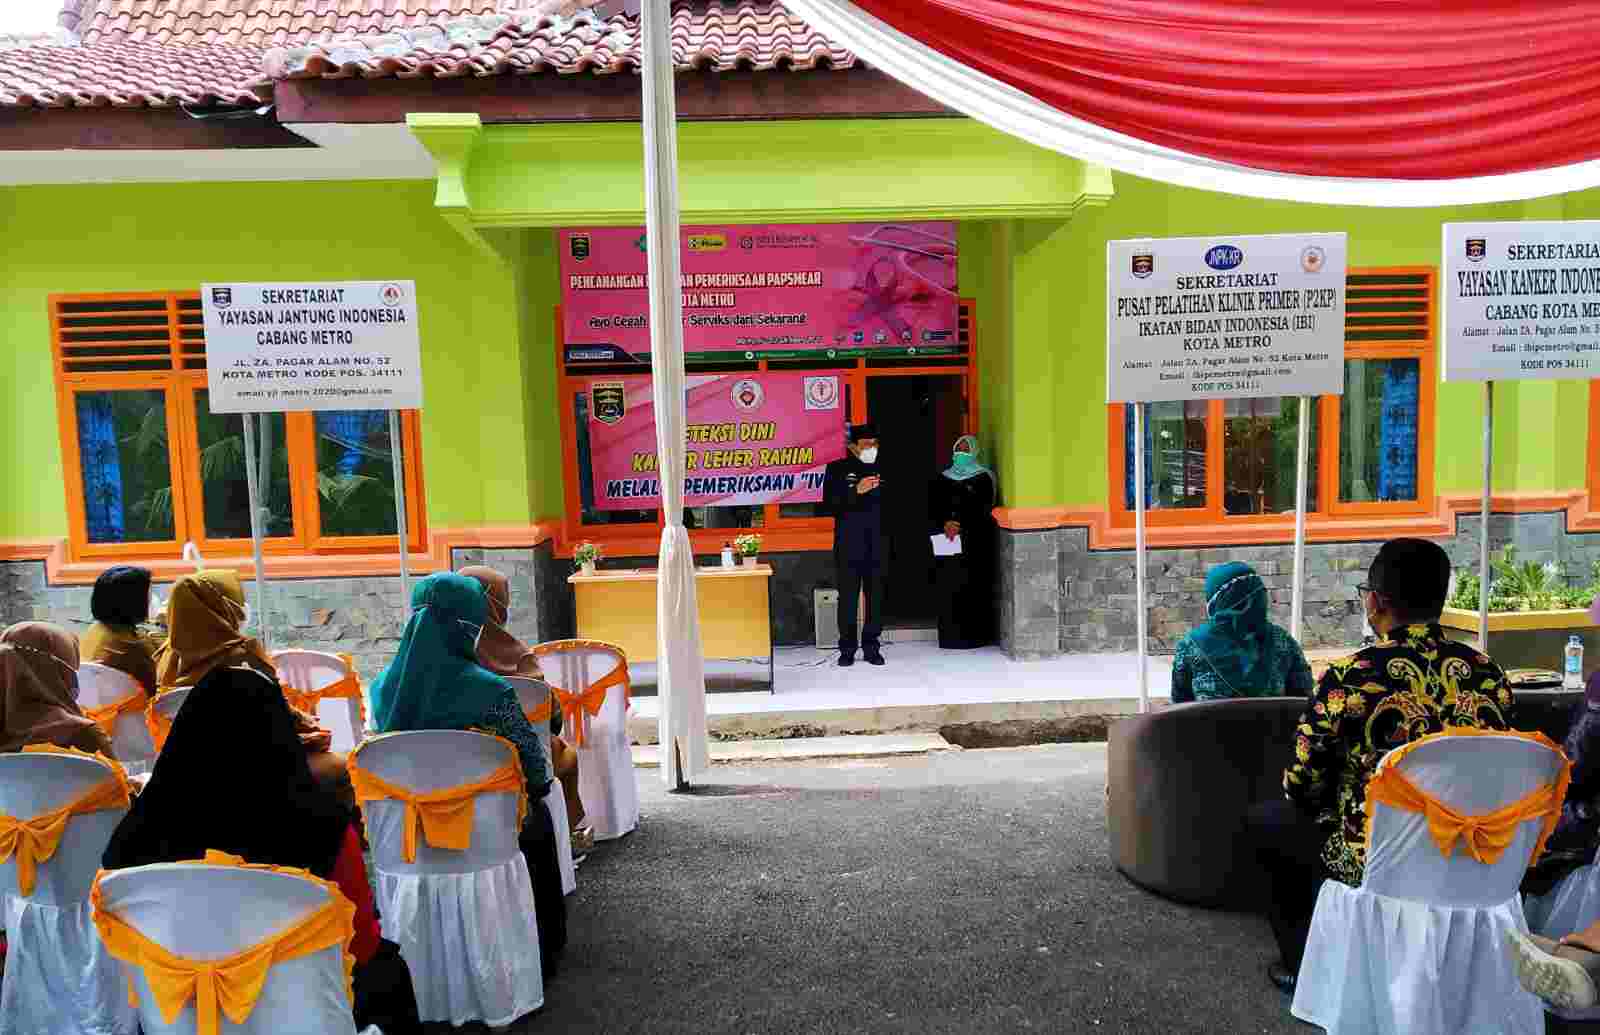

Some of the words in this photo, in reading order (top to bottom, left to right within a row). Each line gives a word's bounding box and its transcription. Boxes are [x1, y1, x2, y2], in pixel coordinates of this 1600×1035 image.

[767, 271, 821, 287] PAPSMEAR
[1176, 273, 1278, 290] SEKRETARIAT
[1458, 269, 1507, 297] YAYASAN
[1510, 268, 1557, 296] KANKER
[262, 288, 345, 304] SEKRETARIAT
[700, 293, 735, 306] METRO
[1117, 298, 1151, 318] PUSAT
[1155, 294, 1216, 316] PELATIHAN
[1218, 292, 1256, 313] KLINIK
[1258, 290, 1300, 311] PRIMER
[1303, 288, 1337, 310] (P2KP)
[218, 309, 274, 326] YAYASAN
[278, 309, 335, 325] JANTUNG
[339, 308, 406, 323] INDONESIA
[689, 314, 730, 325] Serviks
[734, 314, 753, 325] dari
[1486, 304, 1538, 320] CABANG
[1543, 303, 1577, 318] KOTA
[614, 314, 646, 328] Cegah
[1139, 320, 1183, 337] IKATAN
[1186, 318, 1222, 335] BIDAN
[1225, 316, 1289, 333] INDONESIA
[1292, 314, 1316, 332] (IBI)
[256, 330, 307, 346] CABANG
[312, 329, 353, 345] METRO
[1184, 338, 1220, 351] KOTA
[1224, 336, 1272, 350] METRO
[276, 358, 313, 367] PAGAR
[318, 357, 350, 366] ALAM
[377, 356, 392, 365] 52
[1520, 359, 1544, 369] KODE
[222, 370, 254, 379] KOTA
[256, 370, 298, 378] METRO
[304, 369, 336, 378] KODE
[371, 368, 403, 377] 34111
[740, 421, 776, 442] DINI
[704, 447, 753, 469] LEHER
[759, 447, 814, 468] RAHIM
[684, 474, 795, 495] PEMERIKSAAN
